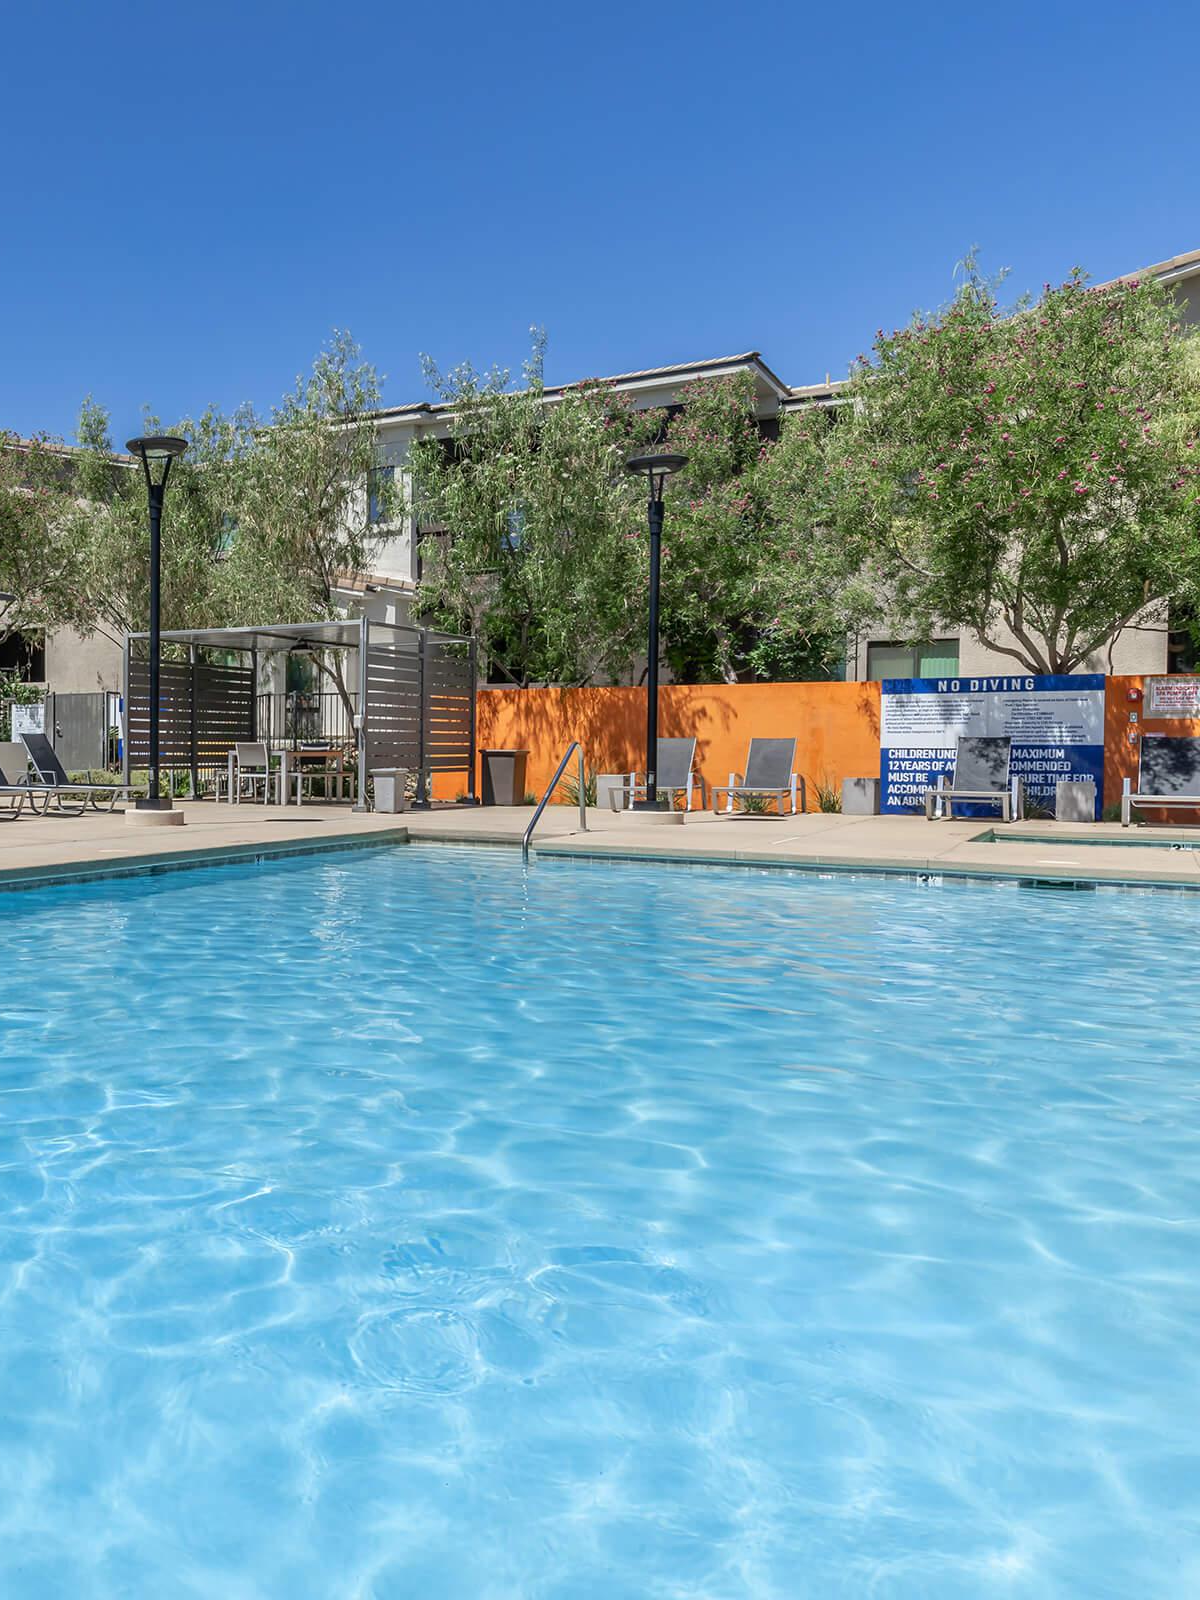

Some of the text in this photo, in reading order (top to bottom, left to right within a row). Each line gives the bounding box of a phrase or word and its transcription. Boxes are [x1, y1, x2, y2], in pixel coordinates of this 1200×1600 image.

[938, 678, 1034, 692] NO DIVING
[888, 749, 936, 759] CHILDREN
[1012, 749, 1065, 759] MAXIMUM
[888, 761, 899, 771] 12
[899, 761, 931, 771] YEARS
[931, 761, 945, 771] OF
[888, 773, 929, 782] MUST BE
[1046, 773, 1072, 783] TIME
[1073, 773, 1094, 783] FOR
[887, 796, 900, 806] AN
